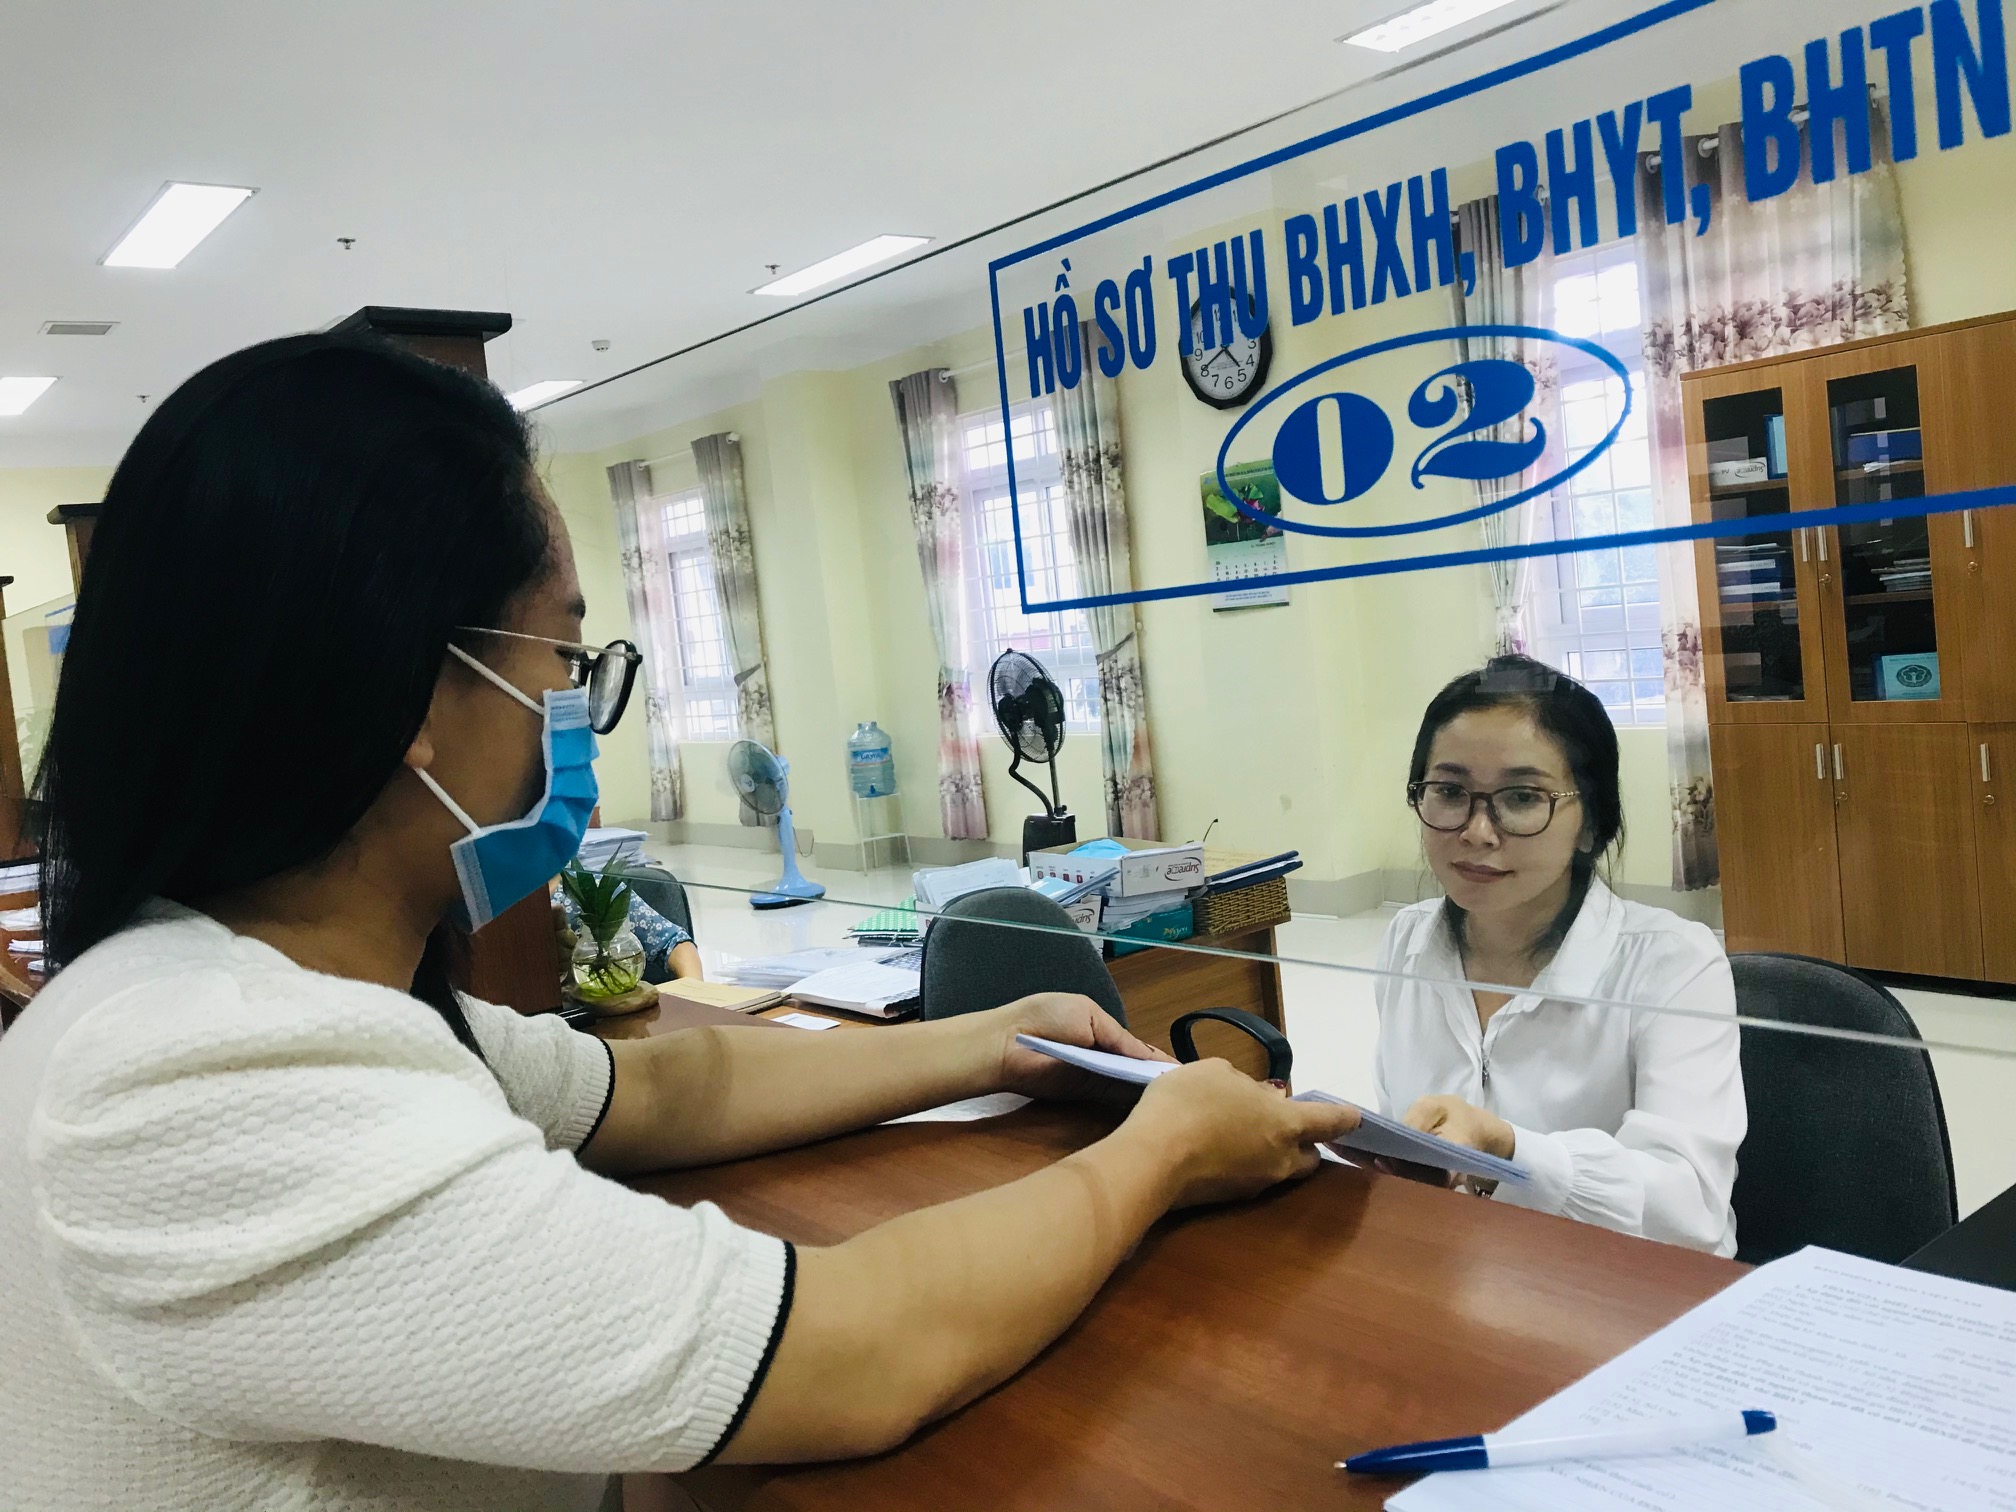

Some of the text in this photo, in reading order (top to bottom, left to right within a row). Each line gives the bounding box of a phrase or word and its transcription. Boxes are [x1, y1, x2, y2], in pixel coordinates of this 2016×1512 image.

[1024, 0, 2011, 398] HỒ SƠ THU BHXH, BHYT, BHTN
[1194, 348, 1204, 362] 9
[1245, 353, 1255, 367] 4
[1200, 364, 1210, 378] 8
[1237, 368, 1247, 382] 5
[1211, 374, 1220, 388] 7
[1224, 376, 1234, 390] 6
[1271, 358, 1546, 506] 02
